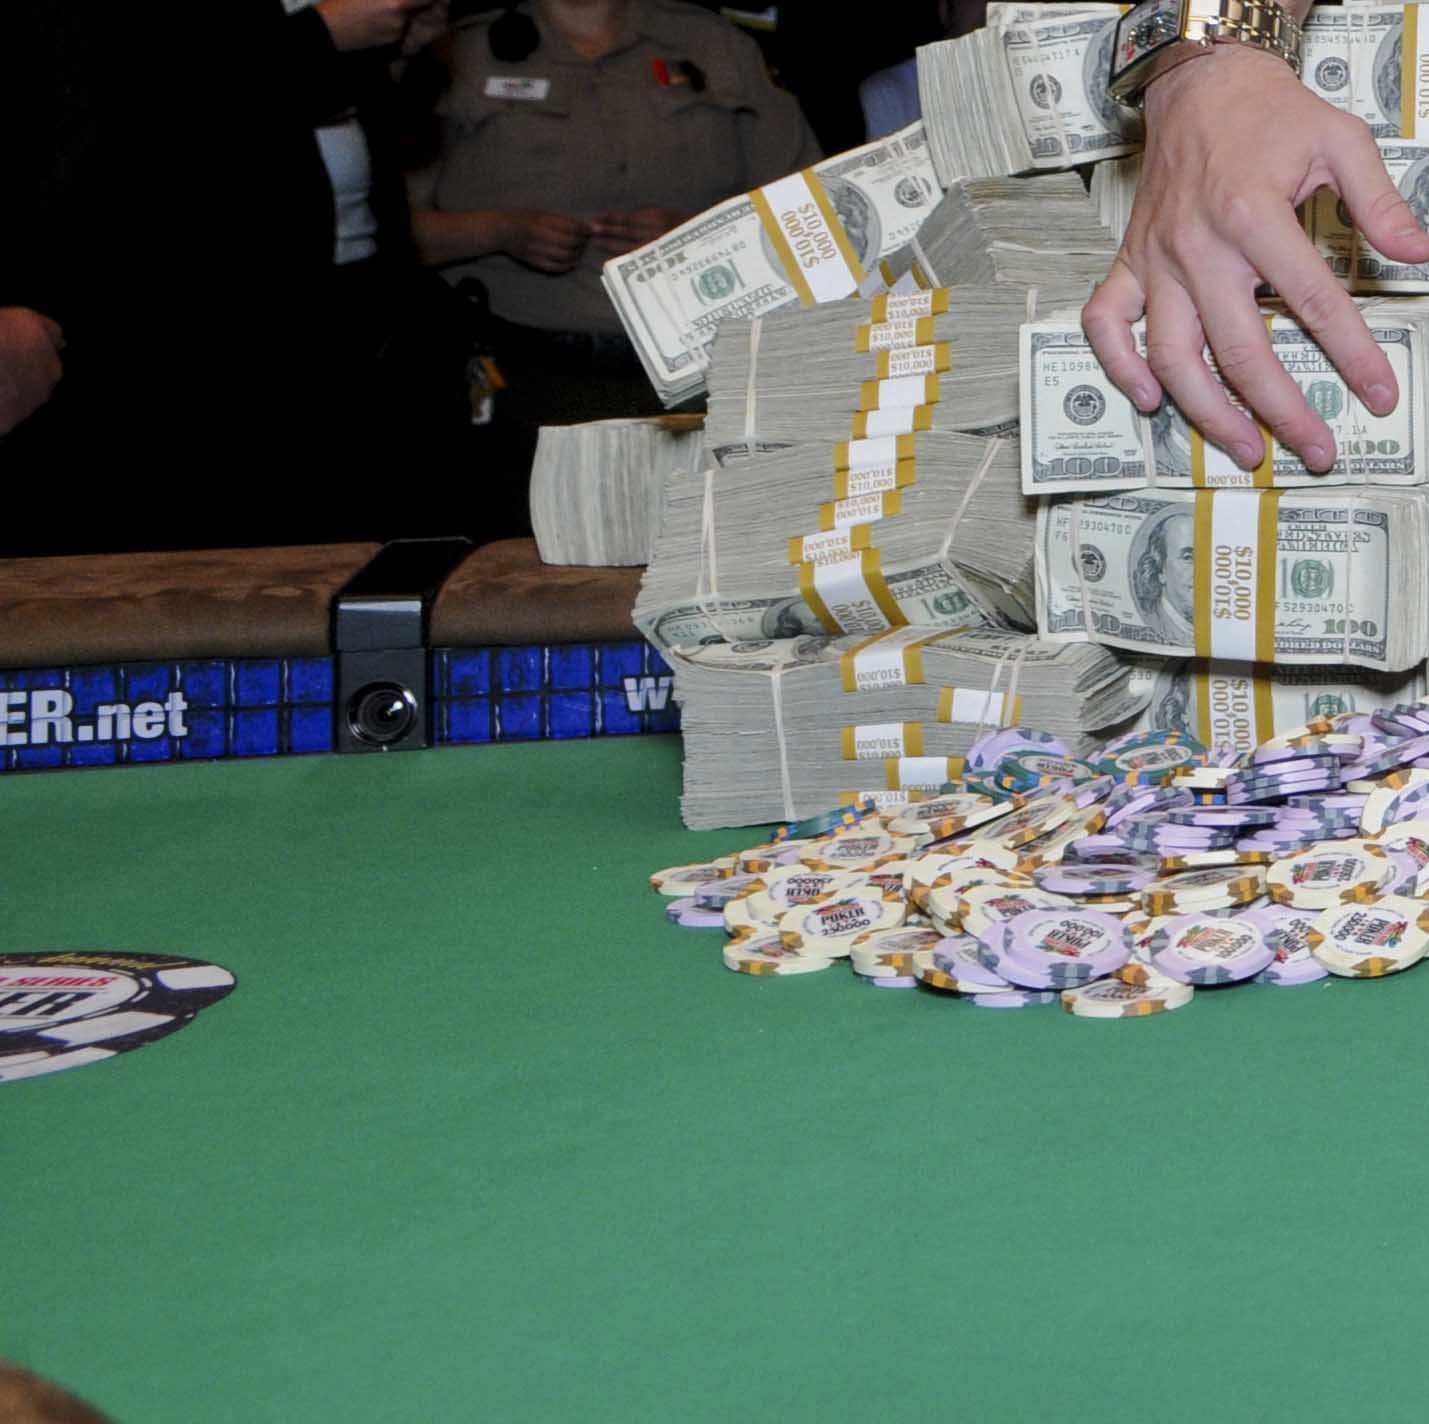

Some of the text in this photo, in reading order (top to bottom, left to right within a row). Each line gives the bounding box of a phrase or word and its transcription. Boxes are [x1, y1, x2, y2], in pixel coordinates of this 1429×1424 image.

[781, 210, 820, 269] $10,000
[799, 202, 836, 260] $10,000
[1053, 456, 1124, 475] 100
[1214, 545, 1233, 619] $10,000
[1234, 545, 1252, 621] $10,000
